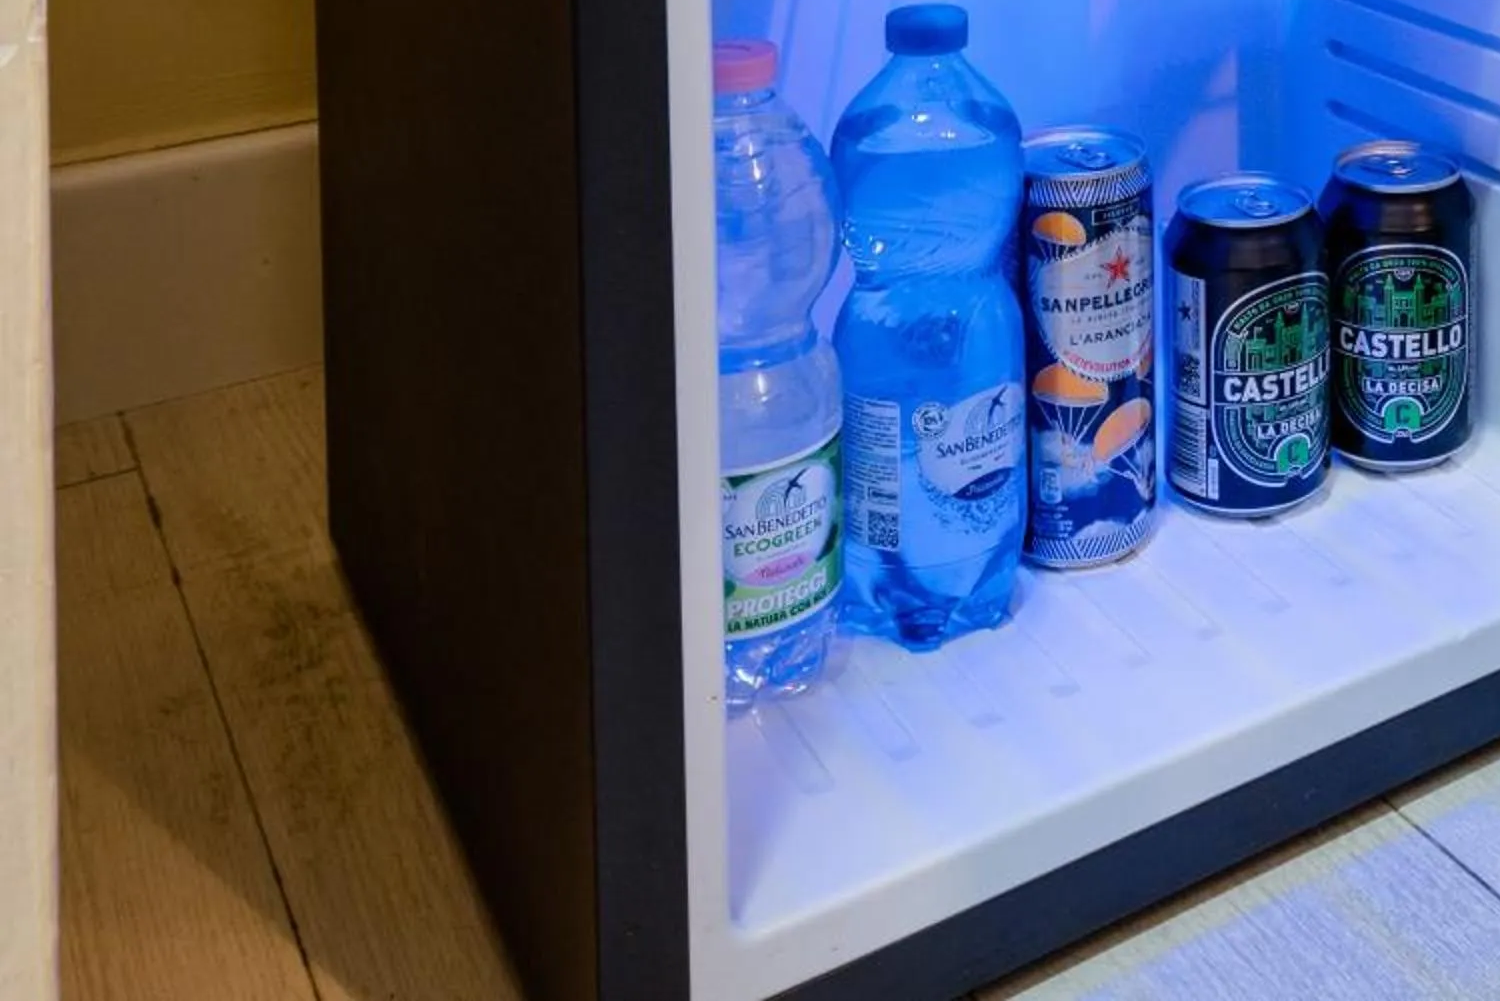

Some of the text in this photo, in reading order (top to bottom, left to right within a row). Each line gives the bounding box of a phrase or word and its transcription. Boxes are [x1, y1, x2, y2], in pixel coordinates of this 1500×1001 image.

[1339, 325, 1462, 359] CASTELLO
[1223, 351, 1328, 402] CASTELL
[1366, 379, 1440, 393] LA DECISA
[1257, 424, 1277, 440] LA
[733, 519, 822, 557] ECOGREEN
[744, 610, 788, 630] NATURA
